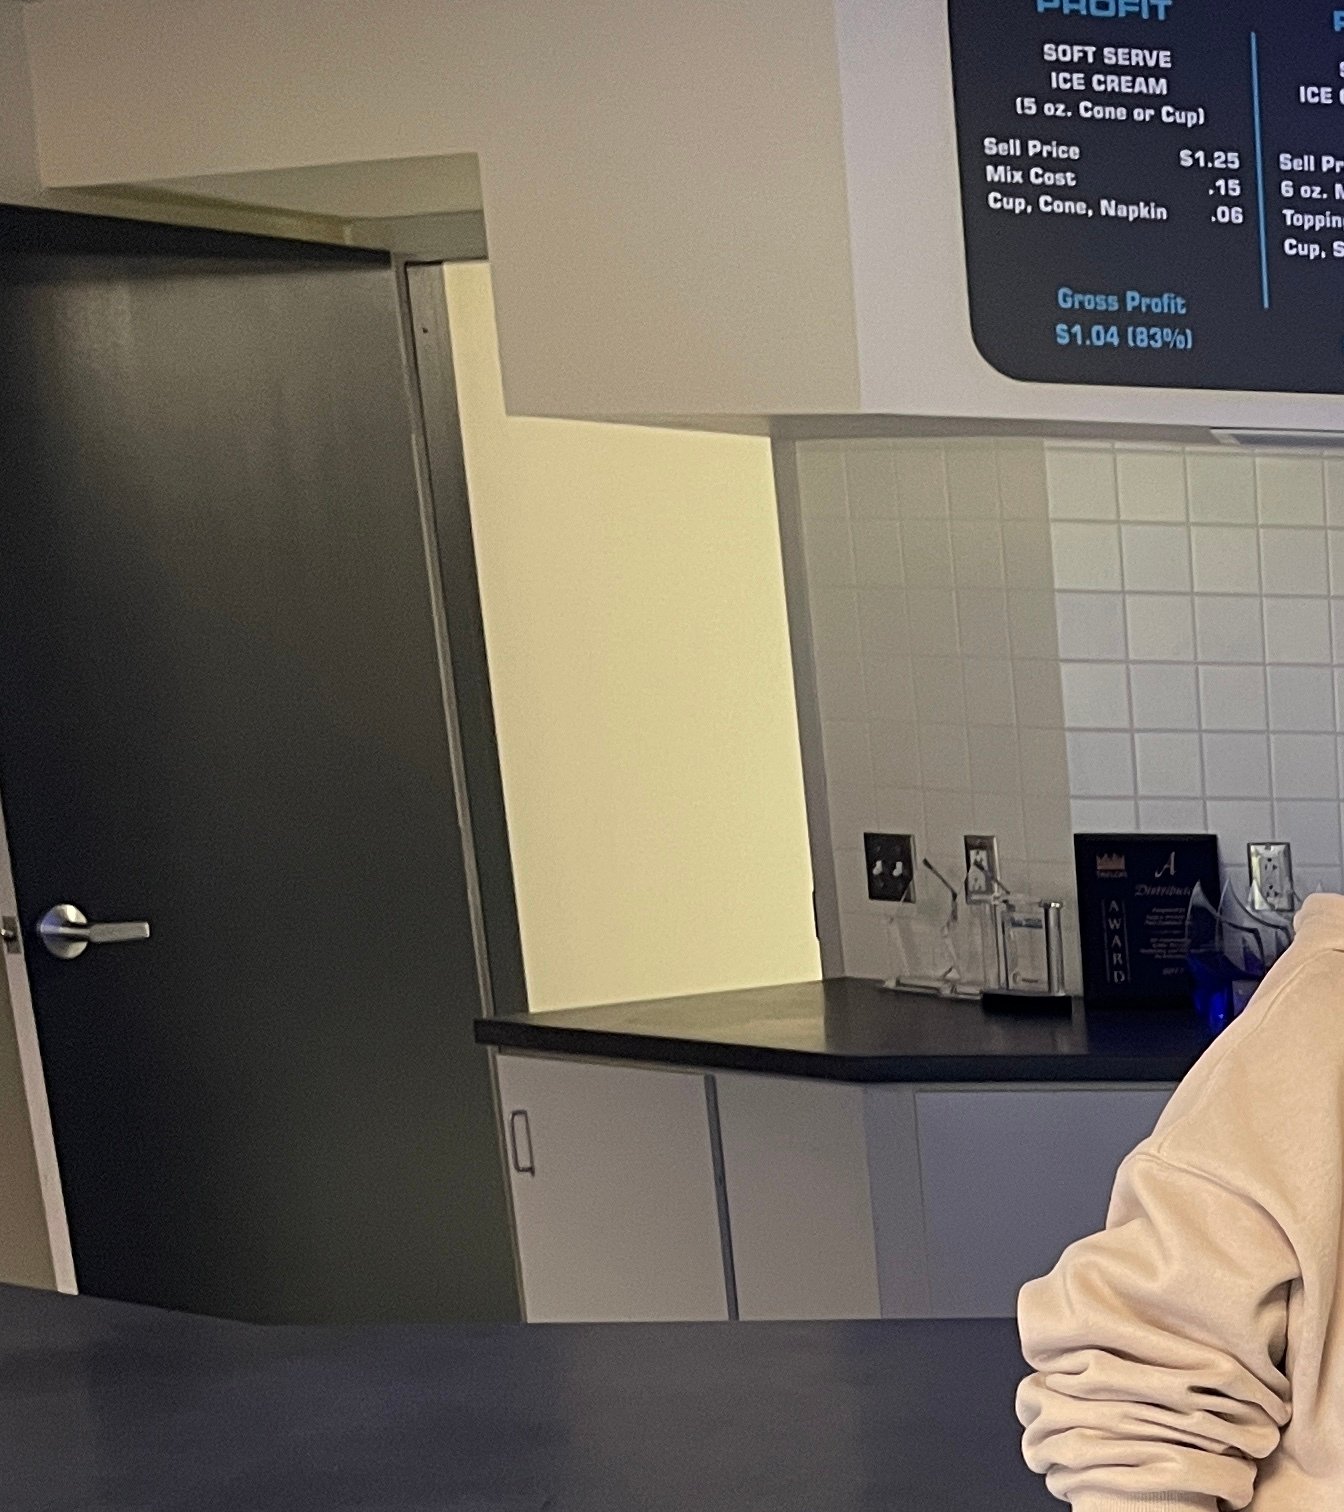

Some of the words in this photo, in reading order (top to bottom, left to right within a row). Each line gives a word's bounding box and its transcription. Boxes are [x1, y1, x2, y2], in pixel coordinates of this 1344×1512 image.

[1037, 0, 1172, 20] PROFIT
[1044, 44, 1096, 63] SOFT
[1104, 47, 1171, 67] SERVE
[1051, 72, 1085, 90] ICE
[1092, 74, 1167, 94] CREAM
[1300, 86, 1332, 103] ICE
[1016, 97, 1036, 114] (5
[1044, 103, 1072, 117] oz.
[1079, 101, 1126, 119] Cone
[1133, 108, 1154, 121] or
[1161, 106, 1204, 127] Cup)
[984, 138, 1020, 156] Sell
[1028, 140, 1079, 159] Price
[1180, 149, 1239, 169] $1.25
[1280, 154, 1314, 171] Sell
[986, 165, 1023, 183] Mix
[1030, 167, 1076, 186] Cost
[1209, 179, 1240, 196] .15
[1281, 181, 1293, 197] 6
[1301, 186, 1327, 198] oz.
[988, 192, 1031, 213] Cup,
[1039, 195, 1092, 217] Cone,
[1101, 199, 1167, 221] Napkin
[1212, 206, 1243, 223] .06
[1284, 239, 1325, 259] Cup,
[1058, 287, 1118, 311] Gross
[1126, 291, 1186, 314] Profit
[1056, 324, 1119, 347] $1.04
[1128, 327, 1192, 349] (83%)
